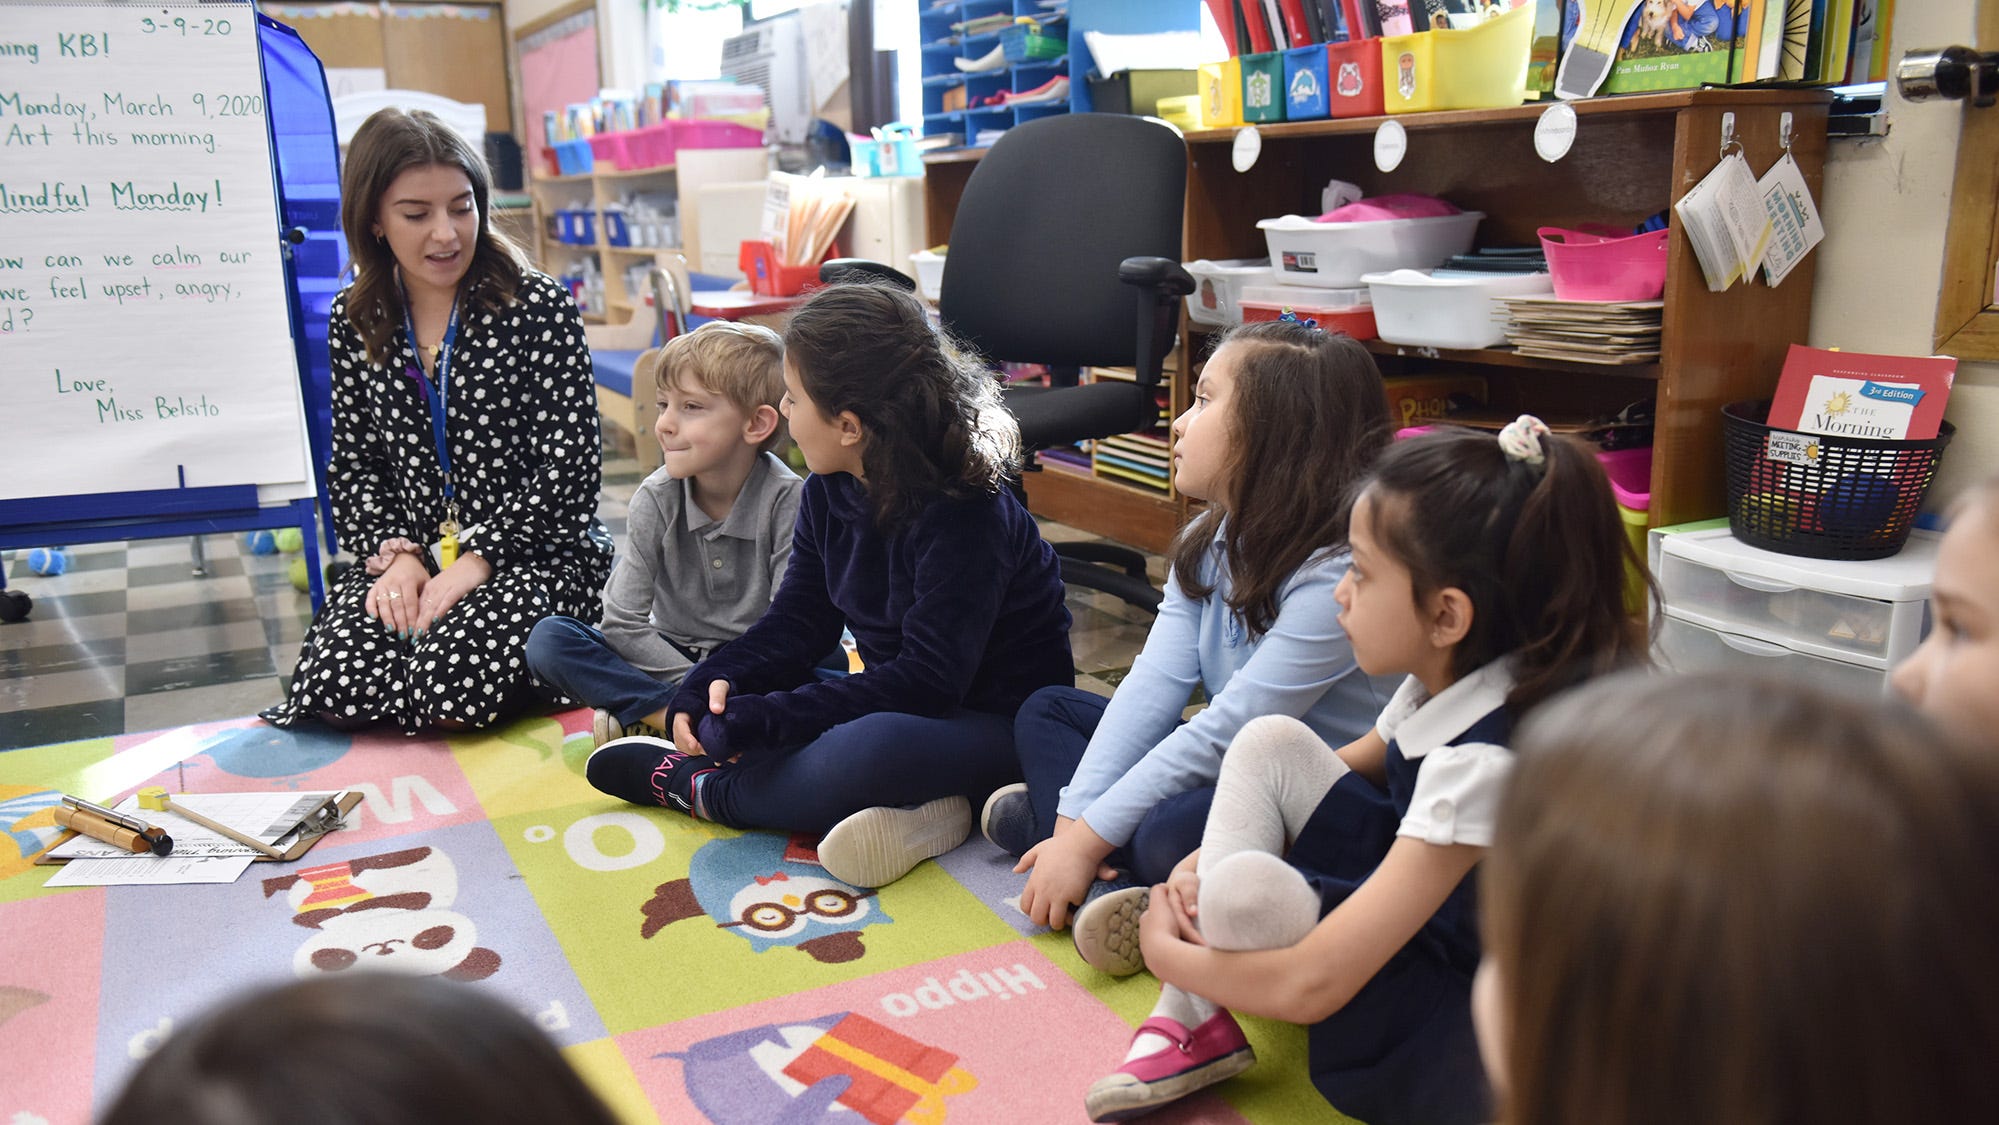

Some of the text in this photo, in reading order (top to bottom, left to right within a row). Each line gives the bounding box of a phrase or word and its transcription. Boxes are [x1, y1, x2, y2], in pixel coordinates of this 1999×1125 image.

[141, 17, 231, 36] 3-9-20
[57, 31, 109, 58] KB!
[1616, 66, 1631, 75] Pam
[1660, 61, 1680, 72] Ryan
[103, 92, 173, 117] March
[5, 123, 52, 146] Art
[73, 122, 118, 146] this
[111, 179, 222, 212] Monday!
[1765, 200, 1797, 262] MEETING
[1771, 190, 1804, 252] MORNING
[45, 255, 83, 267] can
[103, 253, 134, 267] we
[152, 245, 201, 266] calm
[220, 251, 251, 264] our
[50, 276, 87, 299] feel
[175, 280, 241, 303] angry,
[55, 368, 114, 394] Love,
[1869, 386, 1914, 400] 3rd Edition
[96, 395, 220, 423] Miss Belsito
[1852, 406, 1877, 417] THE
[1812, 414, 1895, 439] Morning
[1770, 450, 1802, 460] SUPPLIES
[1771, 440, 1802, 451] MEETING
[880, 963, 1047, 1017] Hippo
